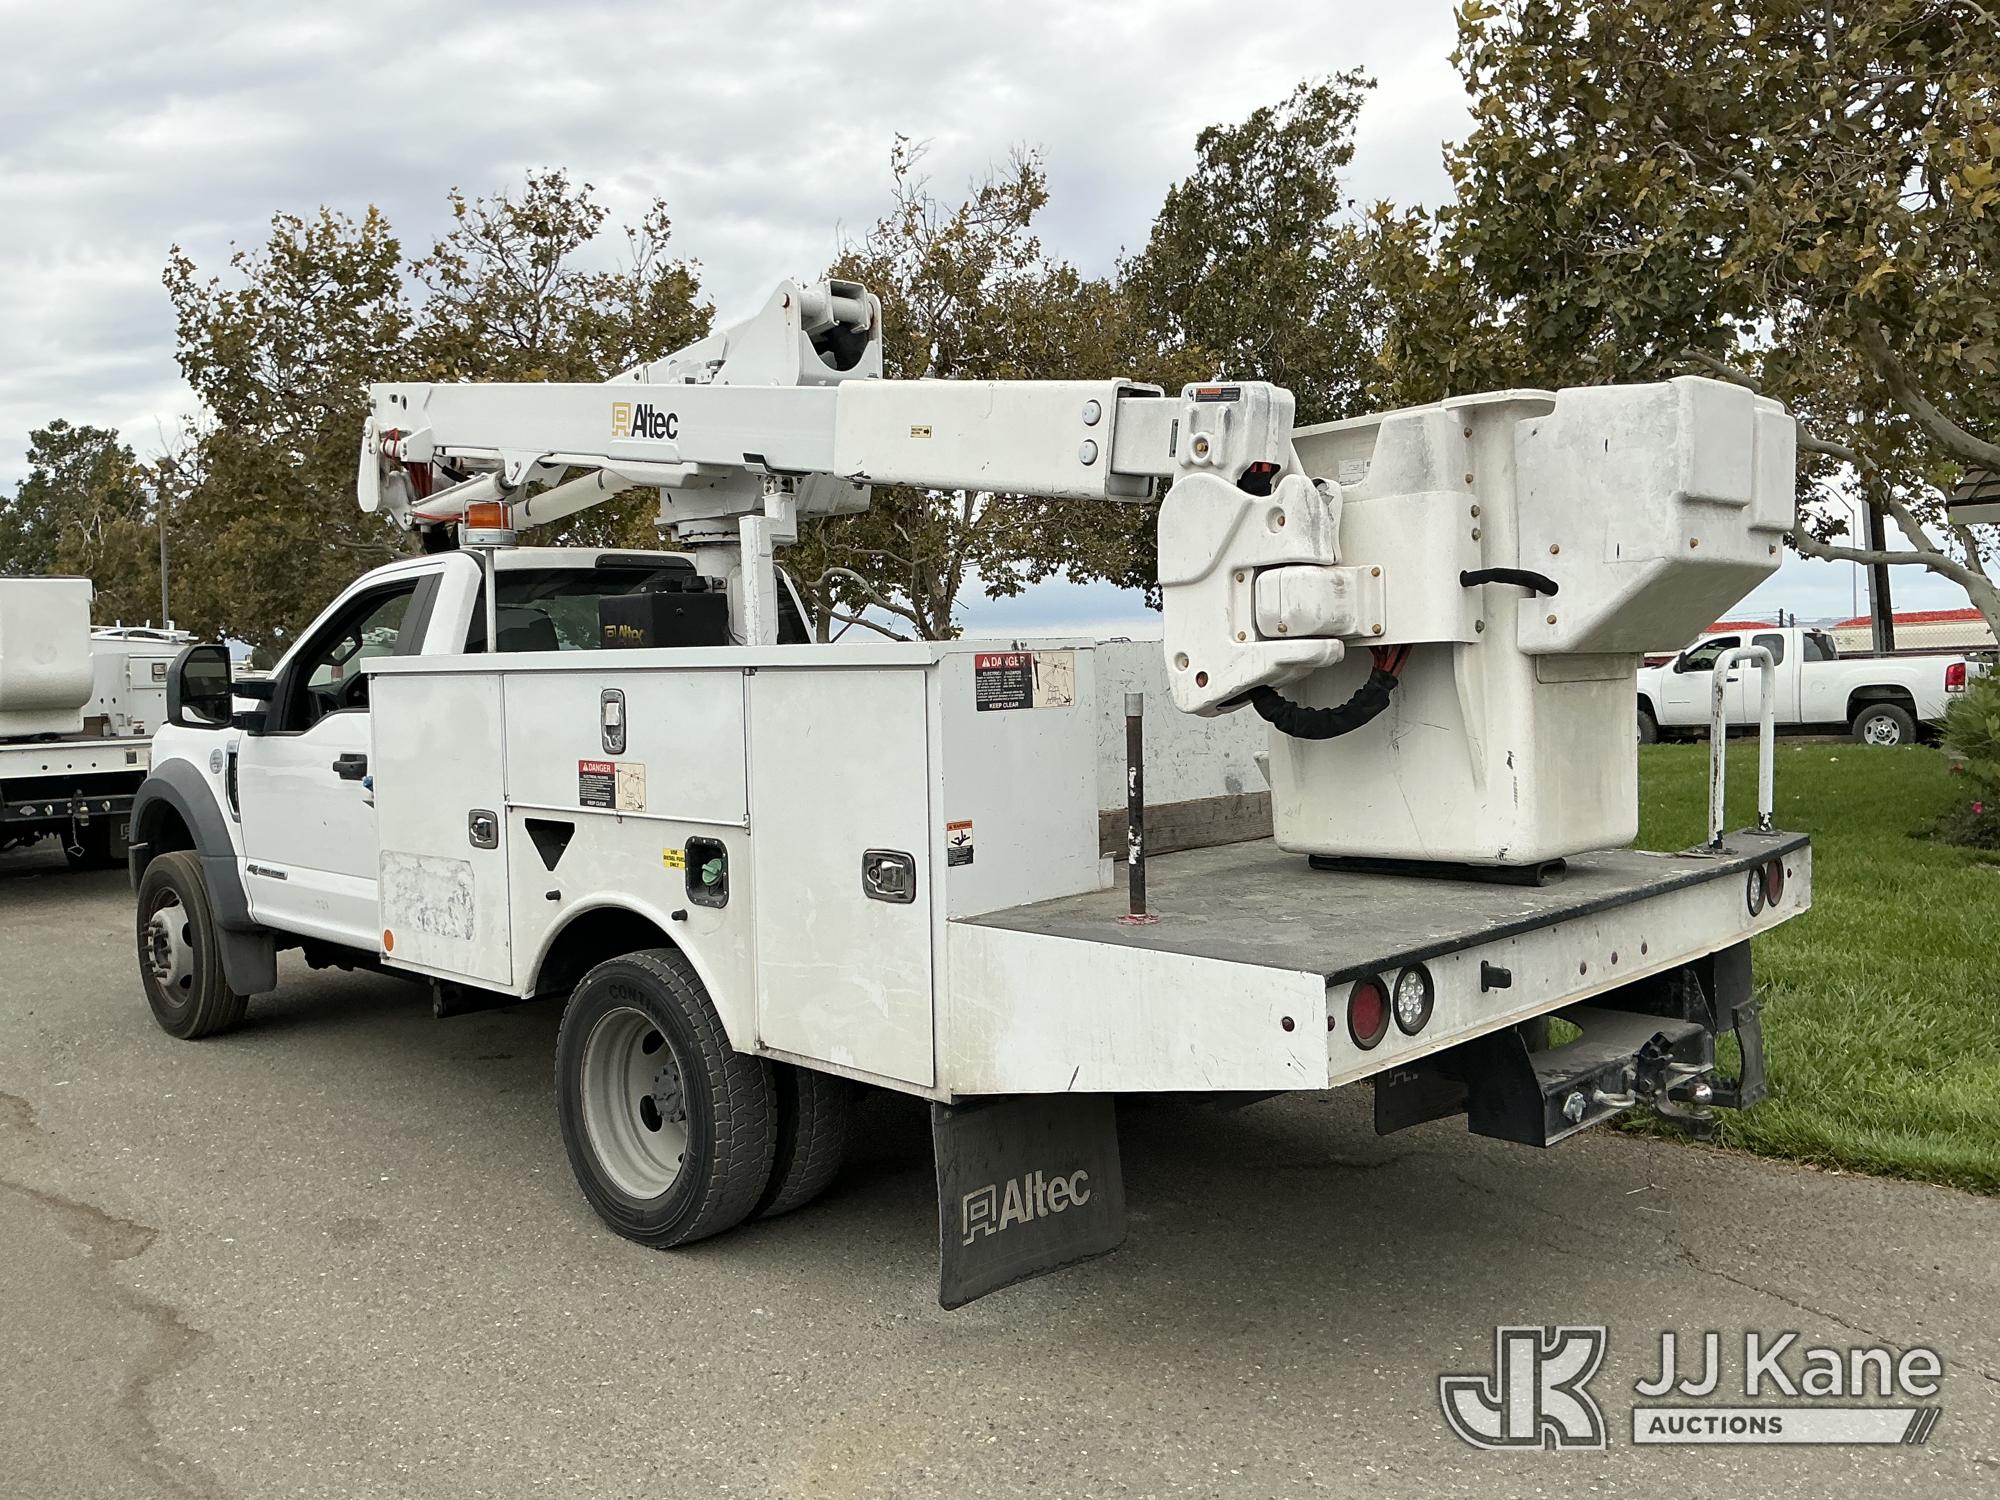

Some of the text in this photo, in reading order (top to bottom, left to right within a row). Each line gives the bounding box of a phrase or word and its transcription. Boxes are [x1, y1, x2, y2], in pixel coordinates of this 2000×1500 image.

[631, 403, 678, 440] Altec
[991, 656, 1025, 667] DANGER
[588, 763, 611, 773] DANGER
[999, 1169, 1091, 1232] Altec
